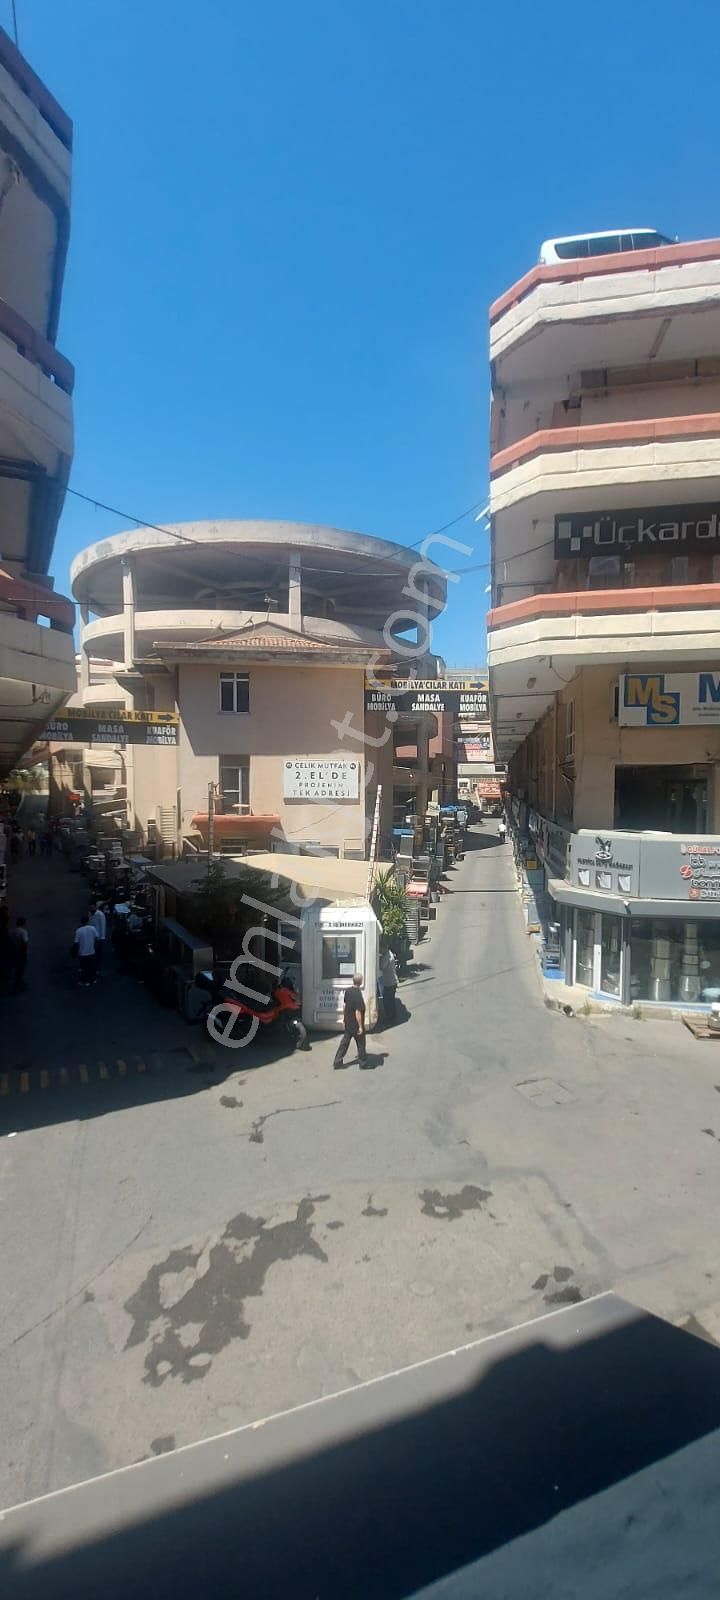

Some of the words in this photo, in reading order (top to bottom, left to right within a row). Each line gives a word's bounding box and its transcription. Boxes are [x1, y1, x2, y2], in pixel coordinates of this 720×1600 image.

[594, 514, 720, 550] Üçkard
[448, 681, 466, 690] KATI
[371, 692, 392, 702] BÜRO
[417, 693, 440, 702] MASA
[460, 692, 487, 702] KUAFÖR
[627, 677, 677, 723] MS
[367, 702, 396, 711] MOBİLYA
[411, 703, 445, 712] SANDALYE
[459, 703, 487, 712] MOBİLYA
[134, 711, 154, 722] KATI
[98, 724, 125, 734] MASA
[147, 724, 176, 736] KUAFÖR
[91, 733, 129, 743] SANDALYE
[146, 734, 177, 745] MOBİLYA
[317, 762, 348, 770] MUTFAK
